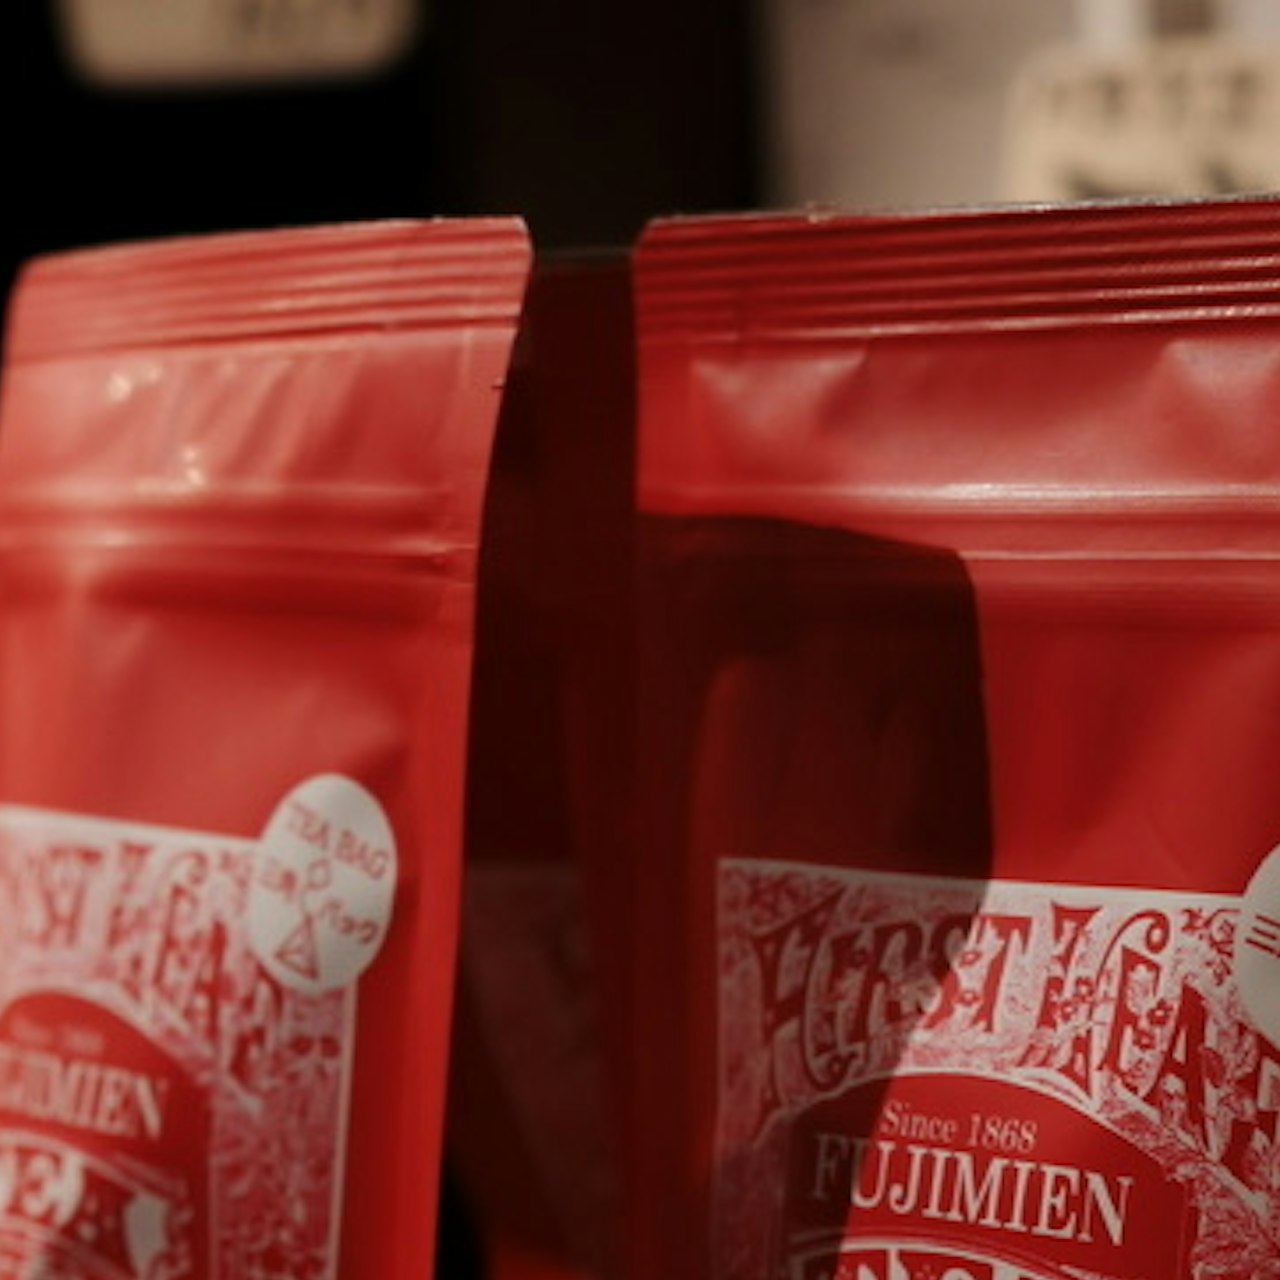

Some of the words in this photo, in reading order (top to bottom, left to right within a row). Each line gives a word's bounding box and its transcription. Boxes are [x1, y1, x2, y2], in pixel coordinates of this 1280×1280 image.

[880, 1098, 958, 1145] Since
[967, 1112, 1039, 1153] 1868
[814, 1132, 1135, 1247] FUJIMIEN
